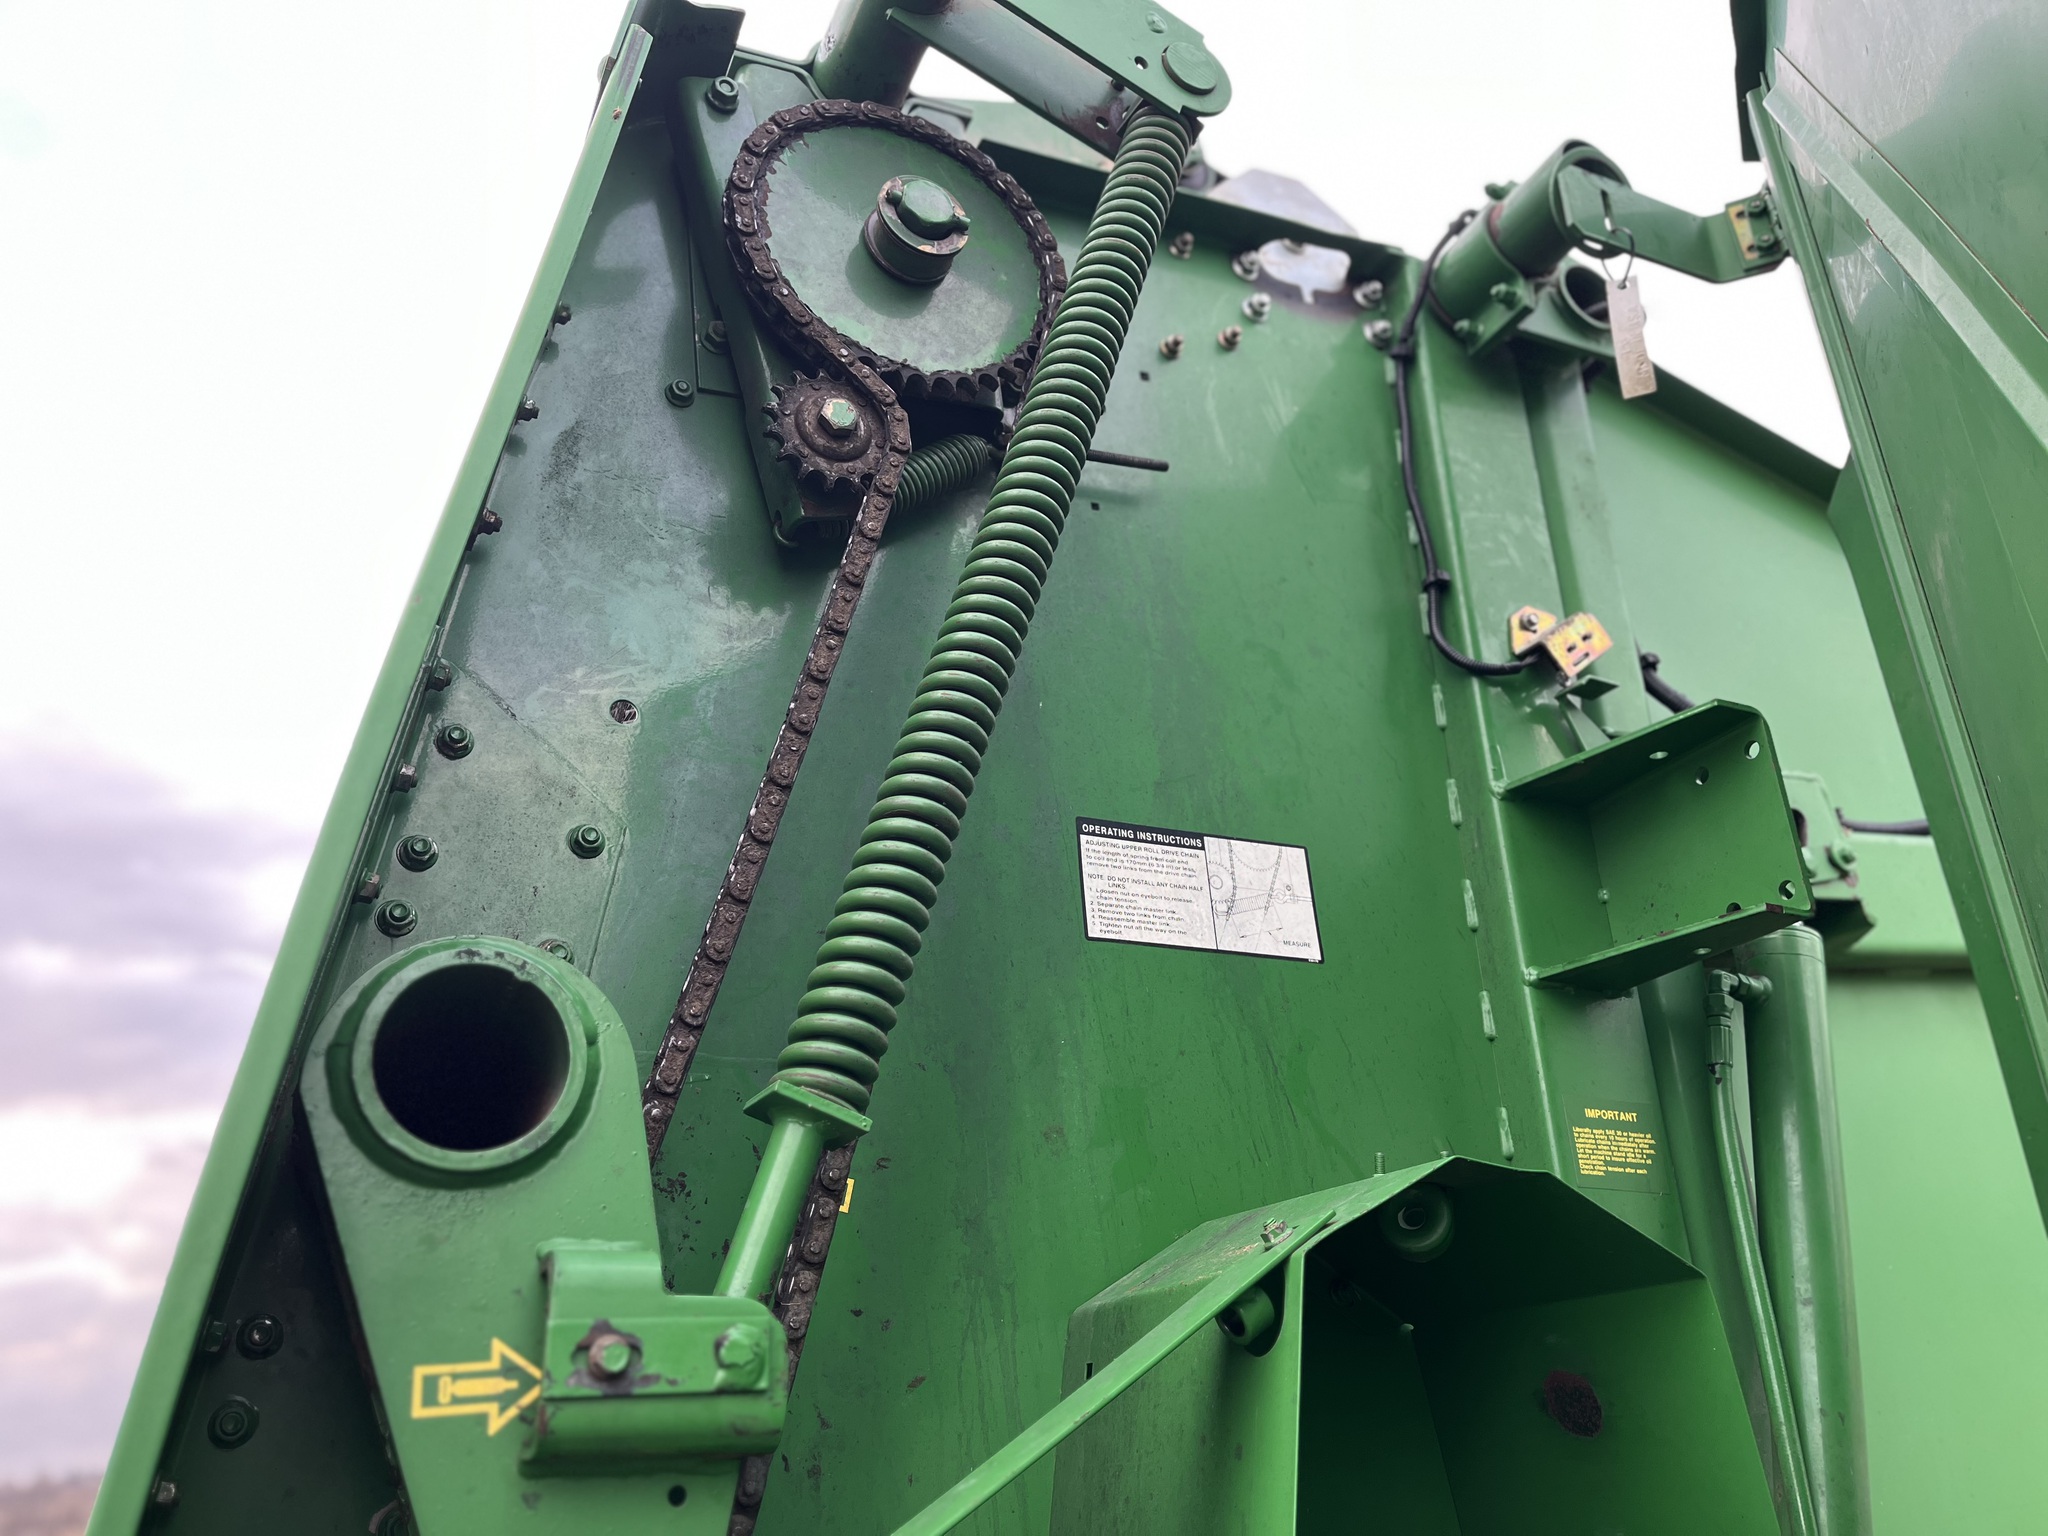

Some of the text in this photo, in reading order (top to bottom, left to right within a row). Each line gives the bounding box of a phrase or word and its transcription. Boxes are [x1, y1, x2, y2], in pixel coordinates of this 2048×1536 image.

[1082, 823, 1202, 847] OPERATING INSTRUCTIONS
[1085, 839, 1200, 859] ADJUSTING UPPER ROLL DRIVE CHAIN
[1117, 876, 1130, 884] NOT
[1130, 878, 1155, 887] INSTALL
[1283, 940, 1311, 948] MEASURE
[1584, 1108, 1638, 1123] IMPORTANT
